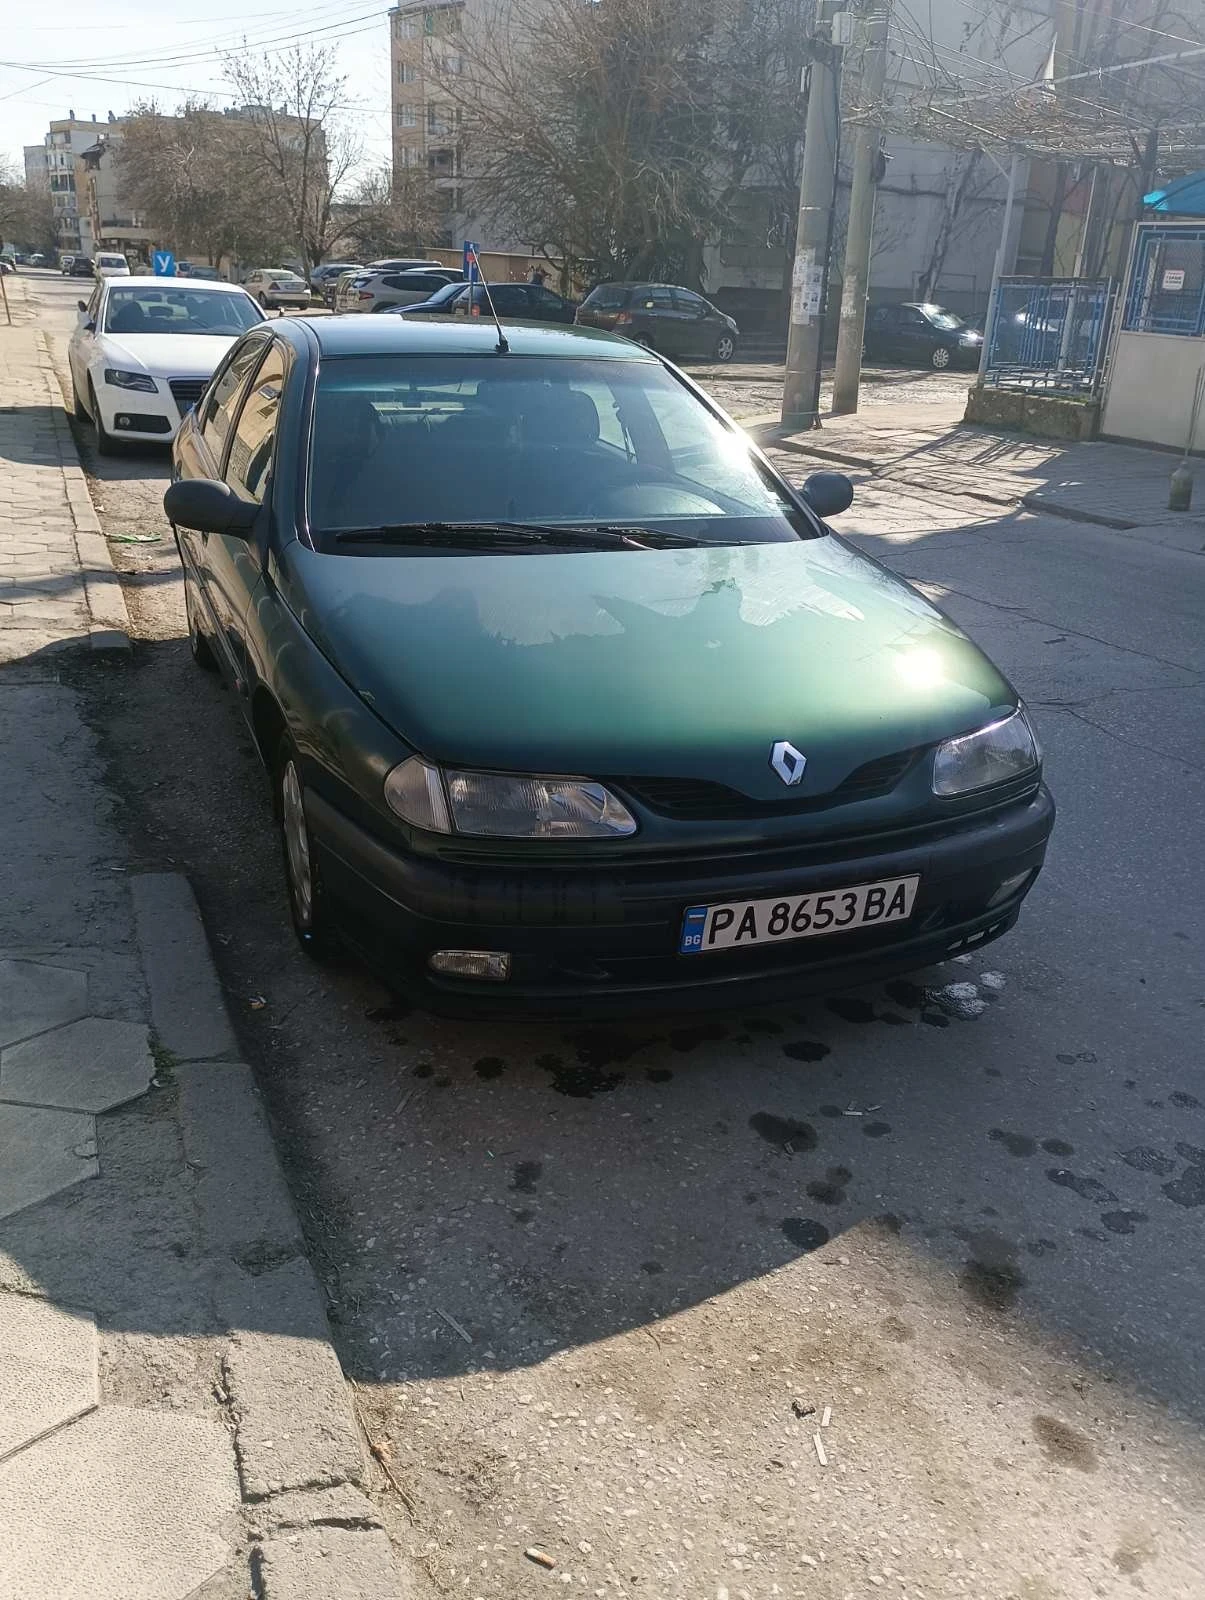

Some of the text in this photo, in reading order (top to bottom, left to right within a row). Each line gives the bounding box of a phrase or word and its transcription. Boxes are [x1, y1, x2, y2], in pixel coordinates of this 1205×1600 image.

[708, 883, 907, 945] PA 8653 BA
[684, 934, 701, 946] BG
